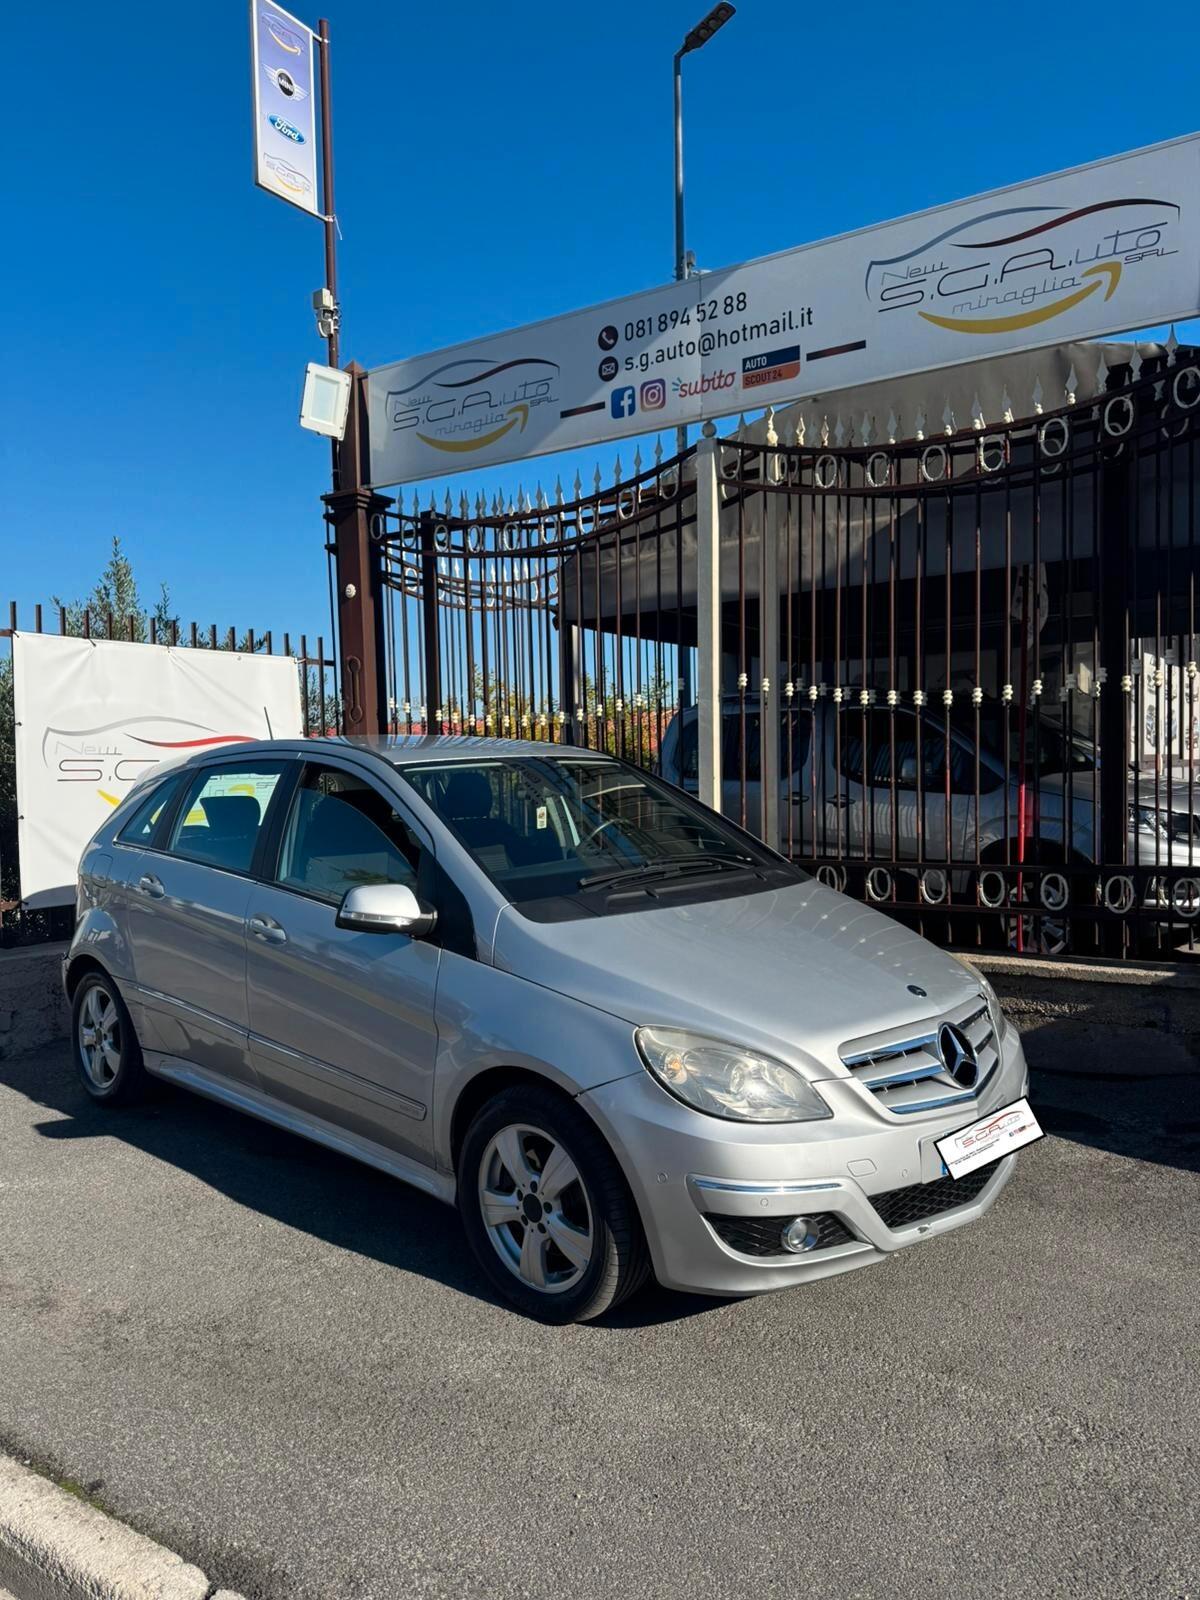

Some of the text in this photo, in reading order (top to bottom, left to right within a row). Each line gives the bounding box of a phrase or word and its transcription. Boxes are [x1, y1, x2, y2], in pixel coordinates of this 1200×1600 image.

[274, 118, 299, 141] Ford
[1124, 249, 1179, 265] SRL
[880, 261, 949, 286] New
[952, 276, 1082, 314] miraglia
[624, 292, 748, 341] 081 894 52 88
[624, 306, 814, 372] s.g.auto@hotmail.it
[744, 356, 768, 370] AUTO
[678, 369, 736, 398] subito
[394, 395, 433, 410] New
[435, 412, 509, 437] miraglia
[54, 741, 122, 756] New
